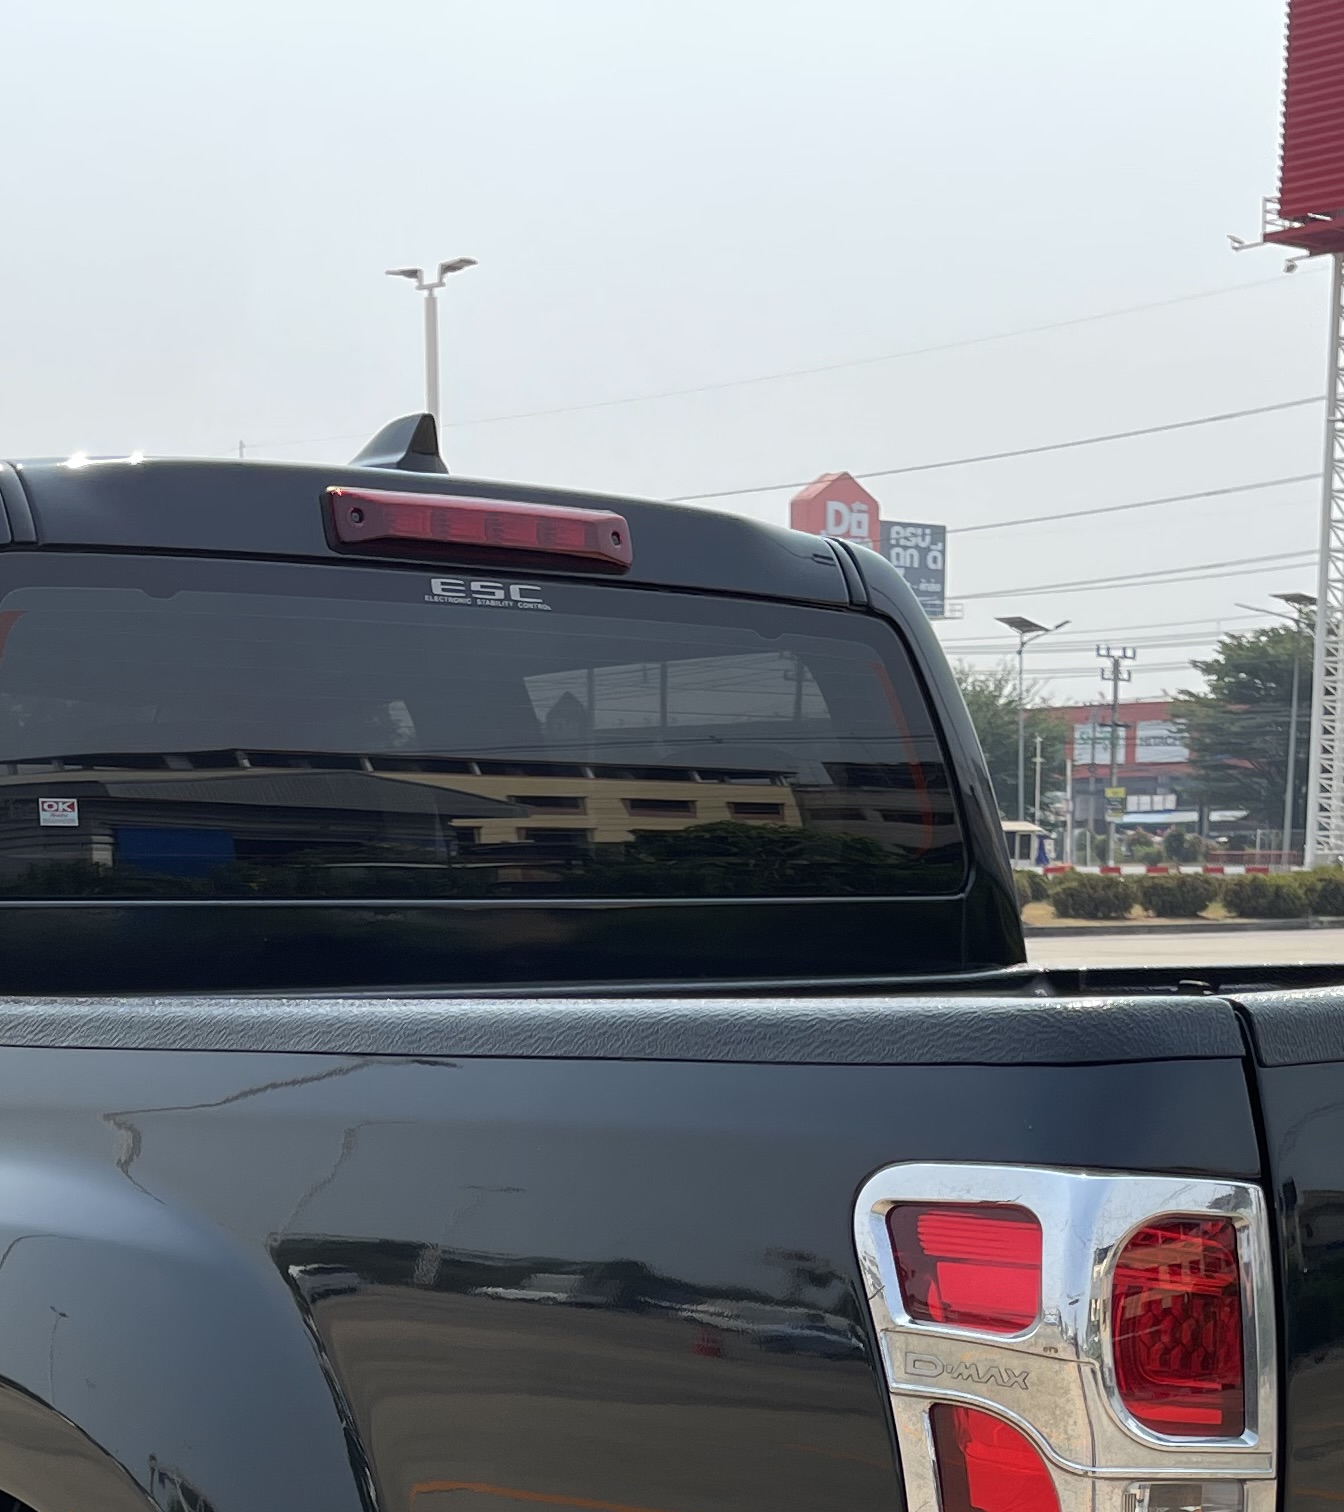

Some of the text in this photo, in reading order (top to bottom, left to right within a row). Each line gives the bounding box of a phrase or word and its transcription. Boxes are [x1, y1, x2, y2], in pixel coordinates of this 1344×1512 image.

[431, 578, 543, 603] ESC
[424, 594, 552, 611] ELECTRONIC STABILITY CONTROL
[43, 801, 74, 812] OK
